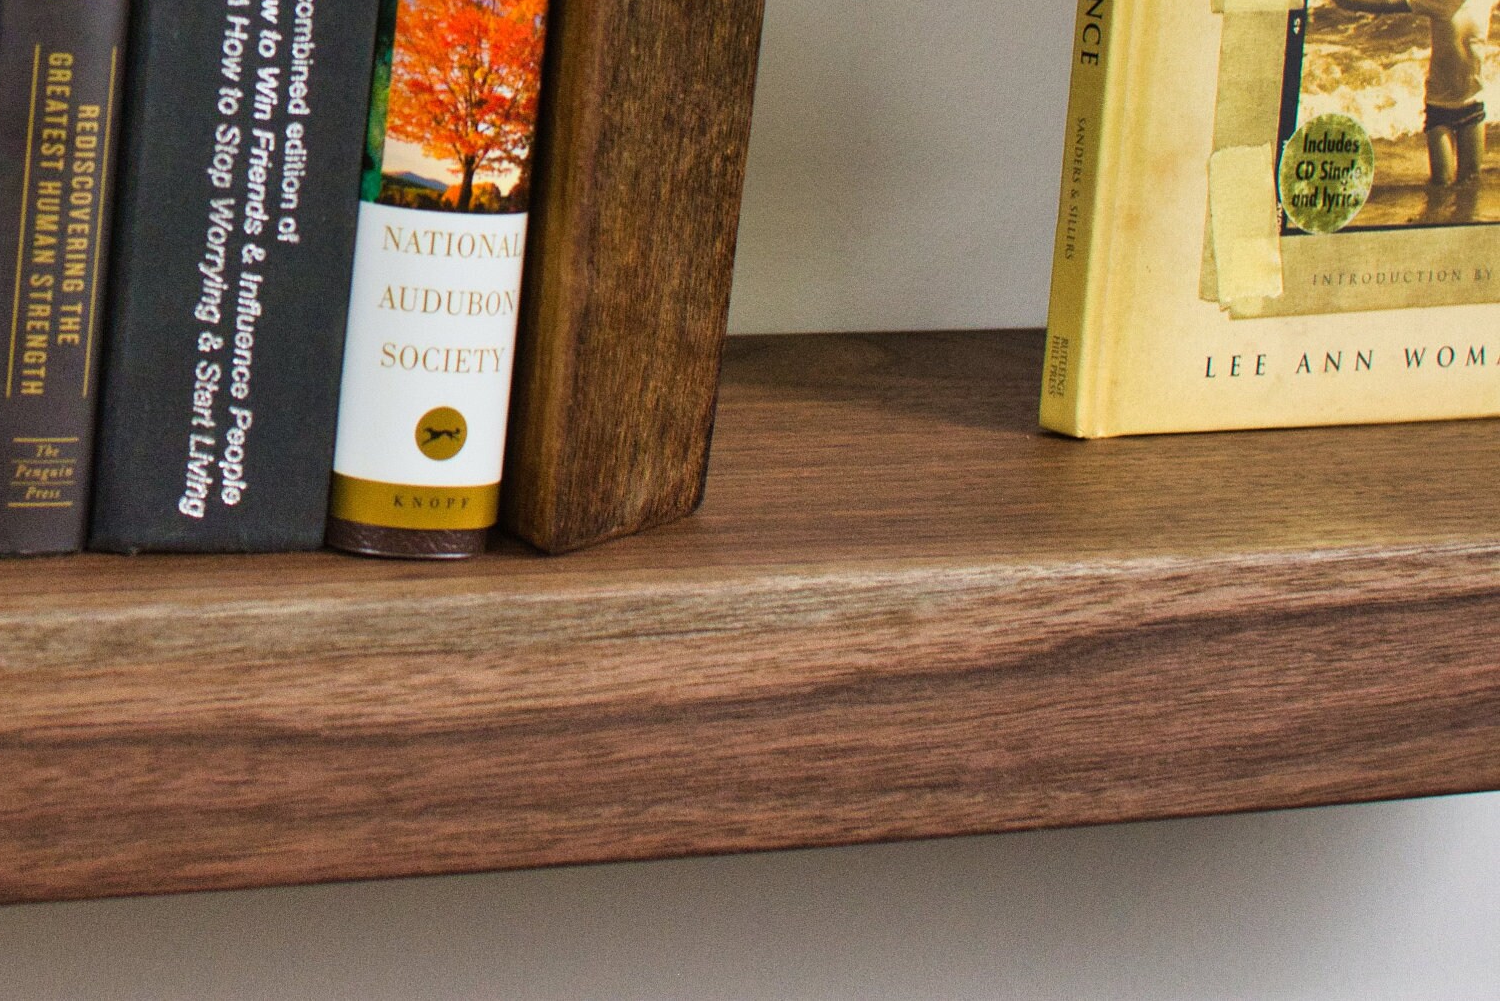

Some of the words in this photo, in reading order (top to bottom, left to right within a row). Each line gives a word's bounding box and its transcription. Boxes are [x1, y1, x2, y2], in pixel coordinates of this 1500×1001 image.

[221, 15, 250, 82] How
[258, 29, 282, 58] to
[217, 87, 243, 116] to
[253, 67, 280, 120] Win
[40, 52, 73, 171] GREATEST
[207, 123, 241, 189] Stop
[1072, 118, 1086, 183] SANDERS
[1303, 131, 1360, 153] Includes
[243, 127, 275, 236] Friends
[280, 122, 307, 209] edition
[1296, 160, 1315, 181] CD
[1319, 159, 1362, 185] Single
[62, 104, 100, 294] REDISCOVERING
[1070, 188, 1079, 199] &
[1292, 186, 1319, 207] and
[1322, 186, 1360, 214] lyrics
[31, 181, 63, 265] HUMAN
[277, 216, 300, 244] of
[241, 243, 266, 264] &
[382, 225, 522, 259] NATIONAL
[194, 198, 235, 324] Worrying
[1311, 268, 1461, 286] INTRODUCTION
[1474, 269, 1493, 281] BY
[377, 284, 517, 316] AUDUBON
[21, 273, 53, 395] STRENGTH
[57, 302, 83, 346] THE
[230, 272, 263, 399] Influence
[197, 331, 224, 352] &
[380, 342, 504, 373] SOCIETY
[1205, 354, 1267, 378] LEE
[1296, 349, 1373, 374] ANN
[1404, 345, 1500, 369] WOM
[191, 360, 221, 427] Start
[35, 444, 61, 458] The
[218, 406, 252, 506] People
[15, 463, 74, 481] Penguin
[178, 433, 215, 518] Living
[25, 484, 62, 500] Press
[393, 494, 470, 510] KNOPF
